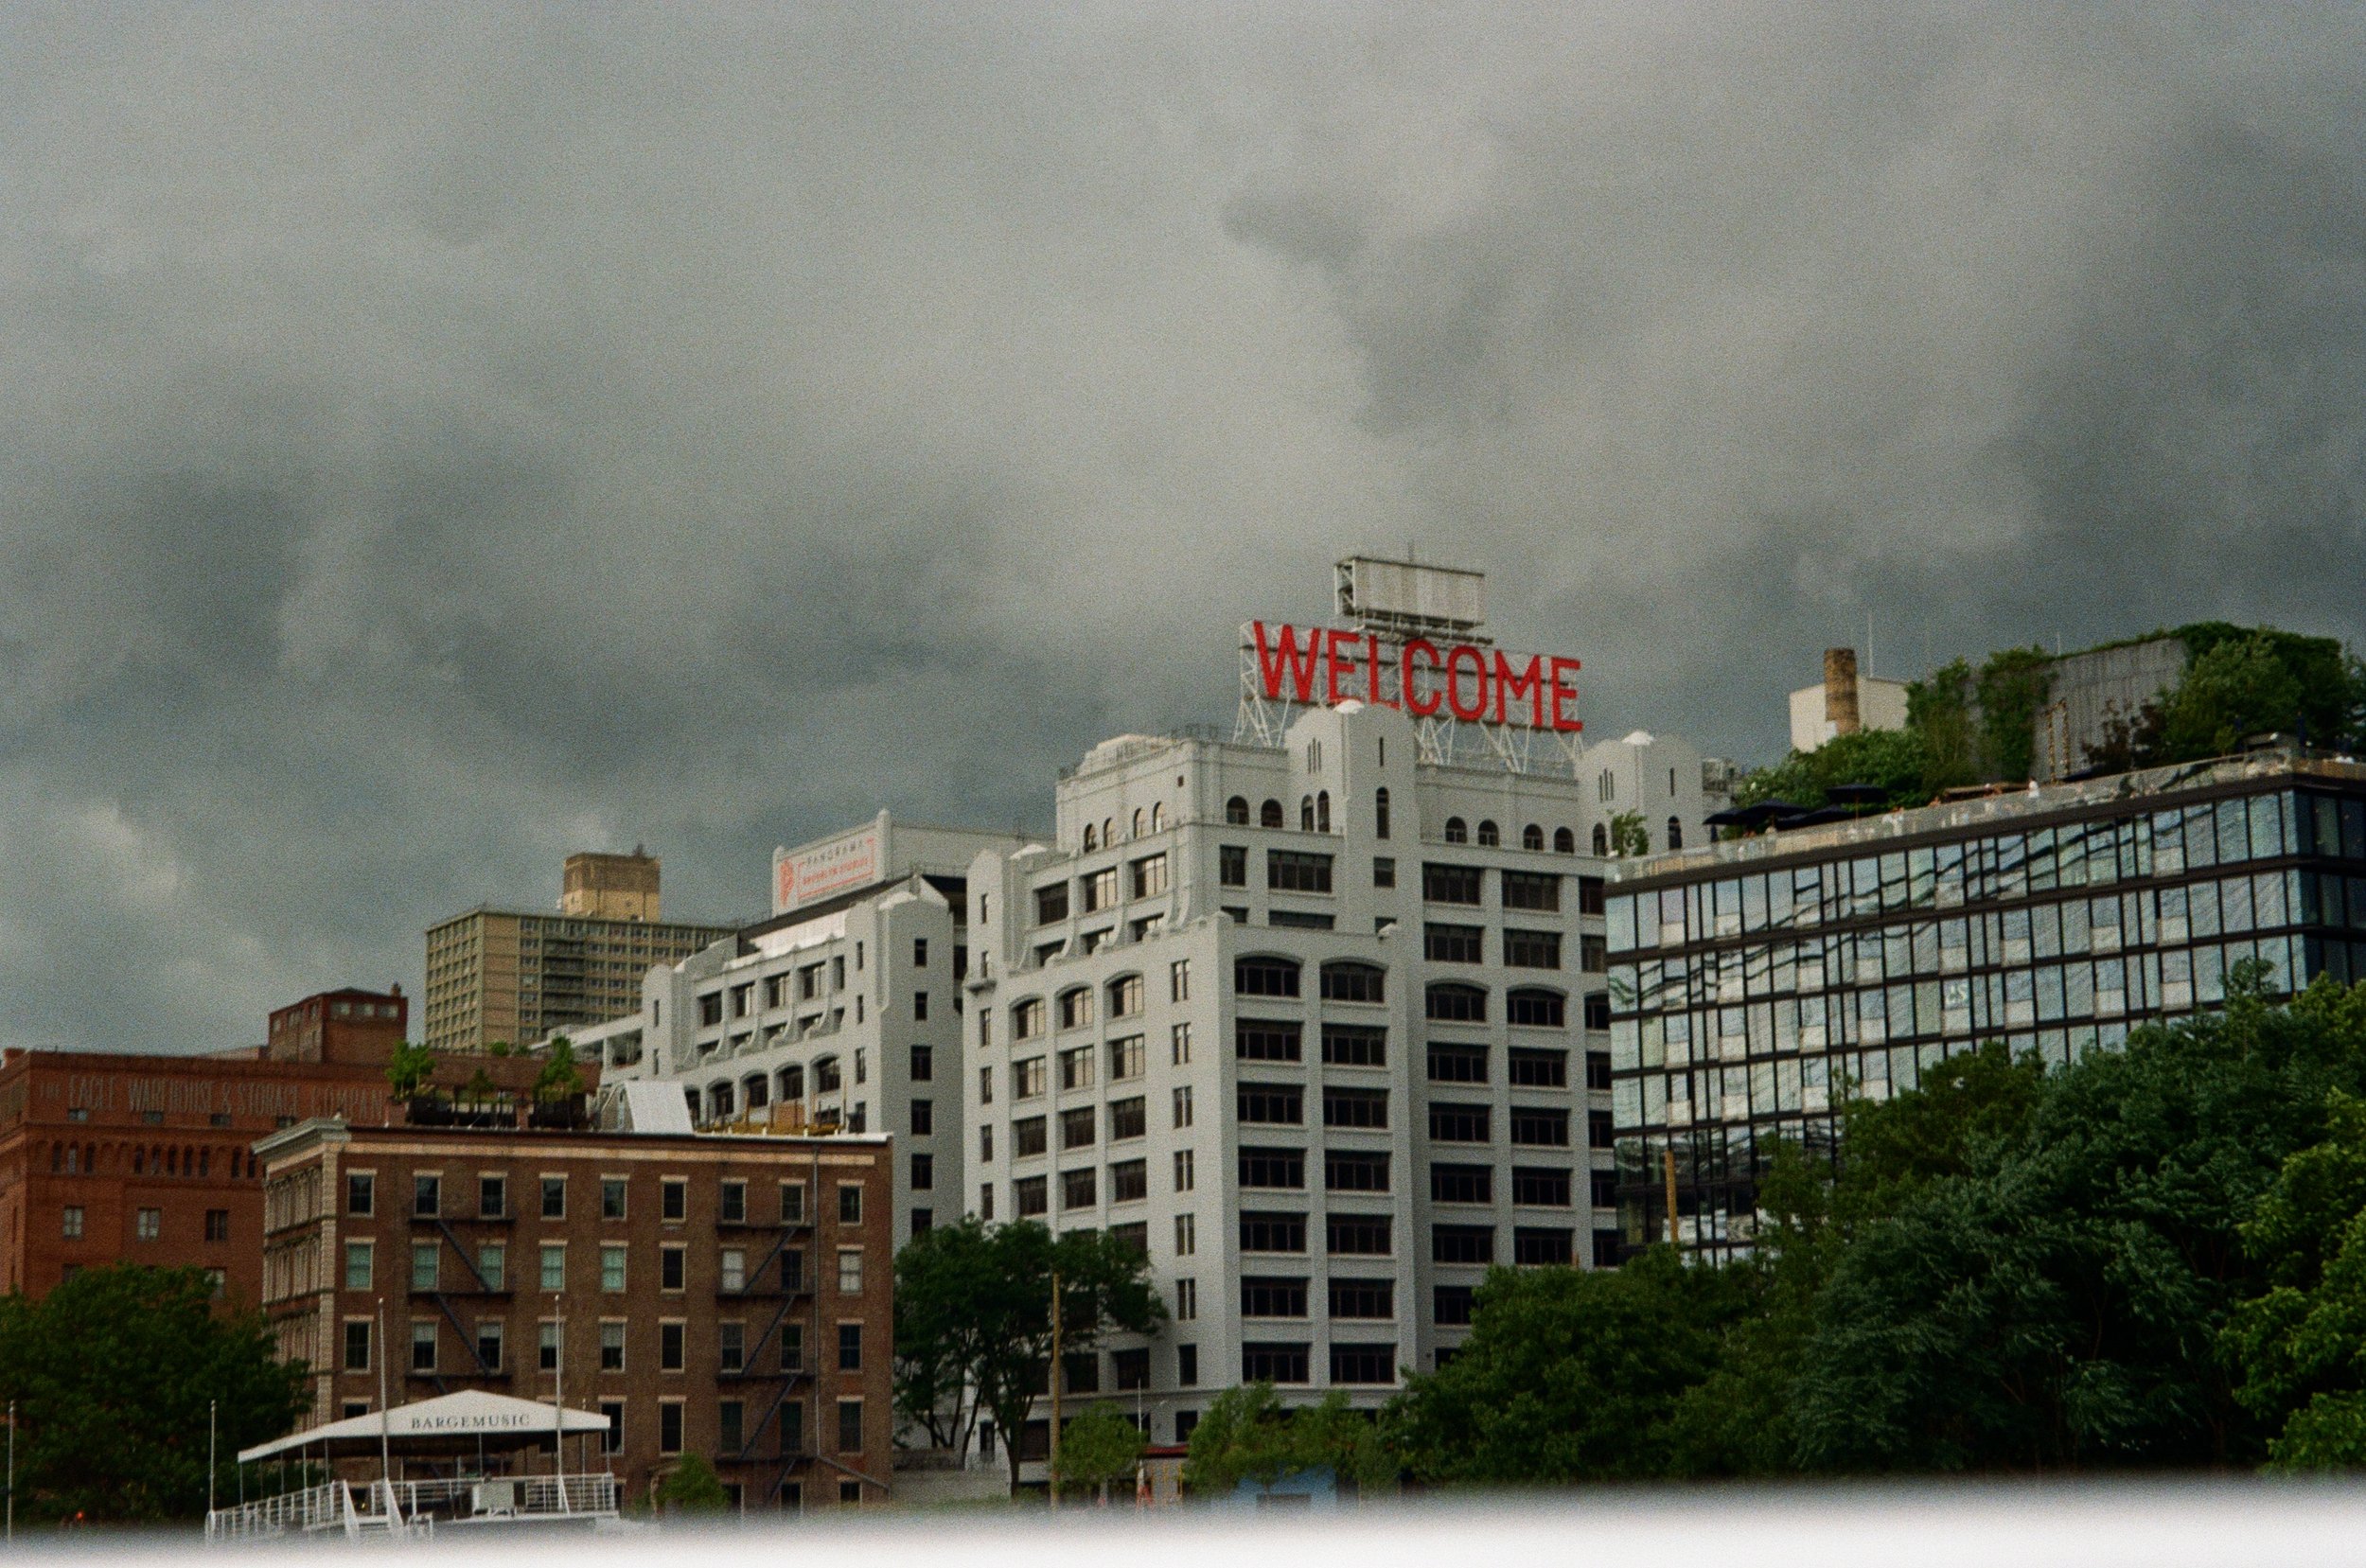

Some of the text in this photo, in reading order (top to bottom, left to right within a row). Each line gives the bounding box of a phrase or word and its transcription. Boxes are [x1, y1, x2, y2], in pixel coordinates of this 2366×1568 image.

[1253, 620, 1583, 731] WELCOME
[69, 1074, 116, 1111] EAGLE
[127, 1076, 214, 1114] WAREHOUSE
[221, 1081, 232, 1115] &
[238, 1082, 299, 1118] STORAGE
[411, 1414, 530, 1429] BARGEMUSIC
